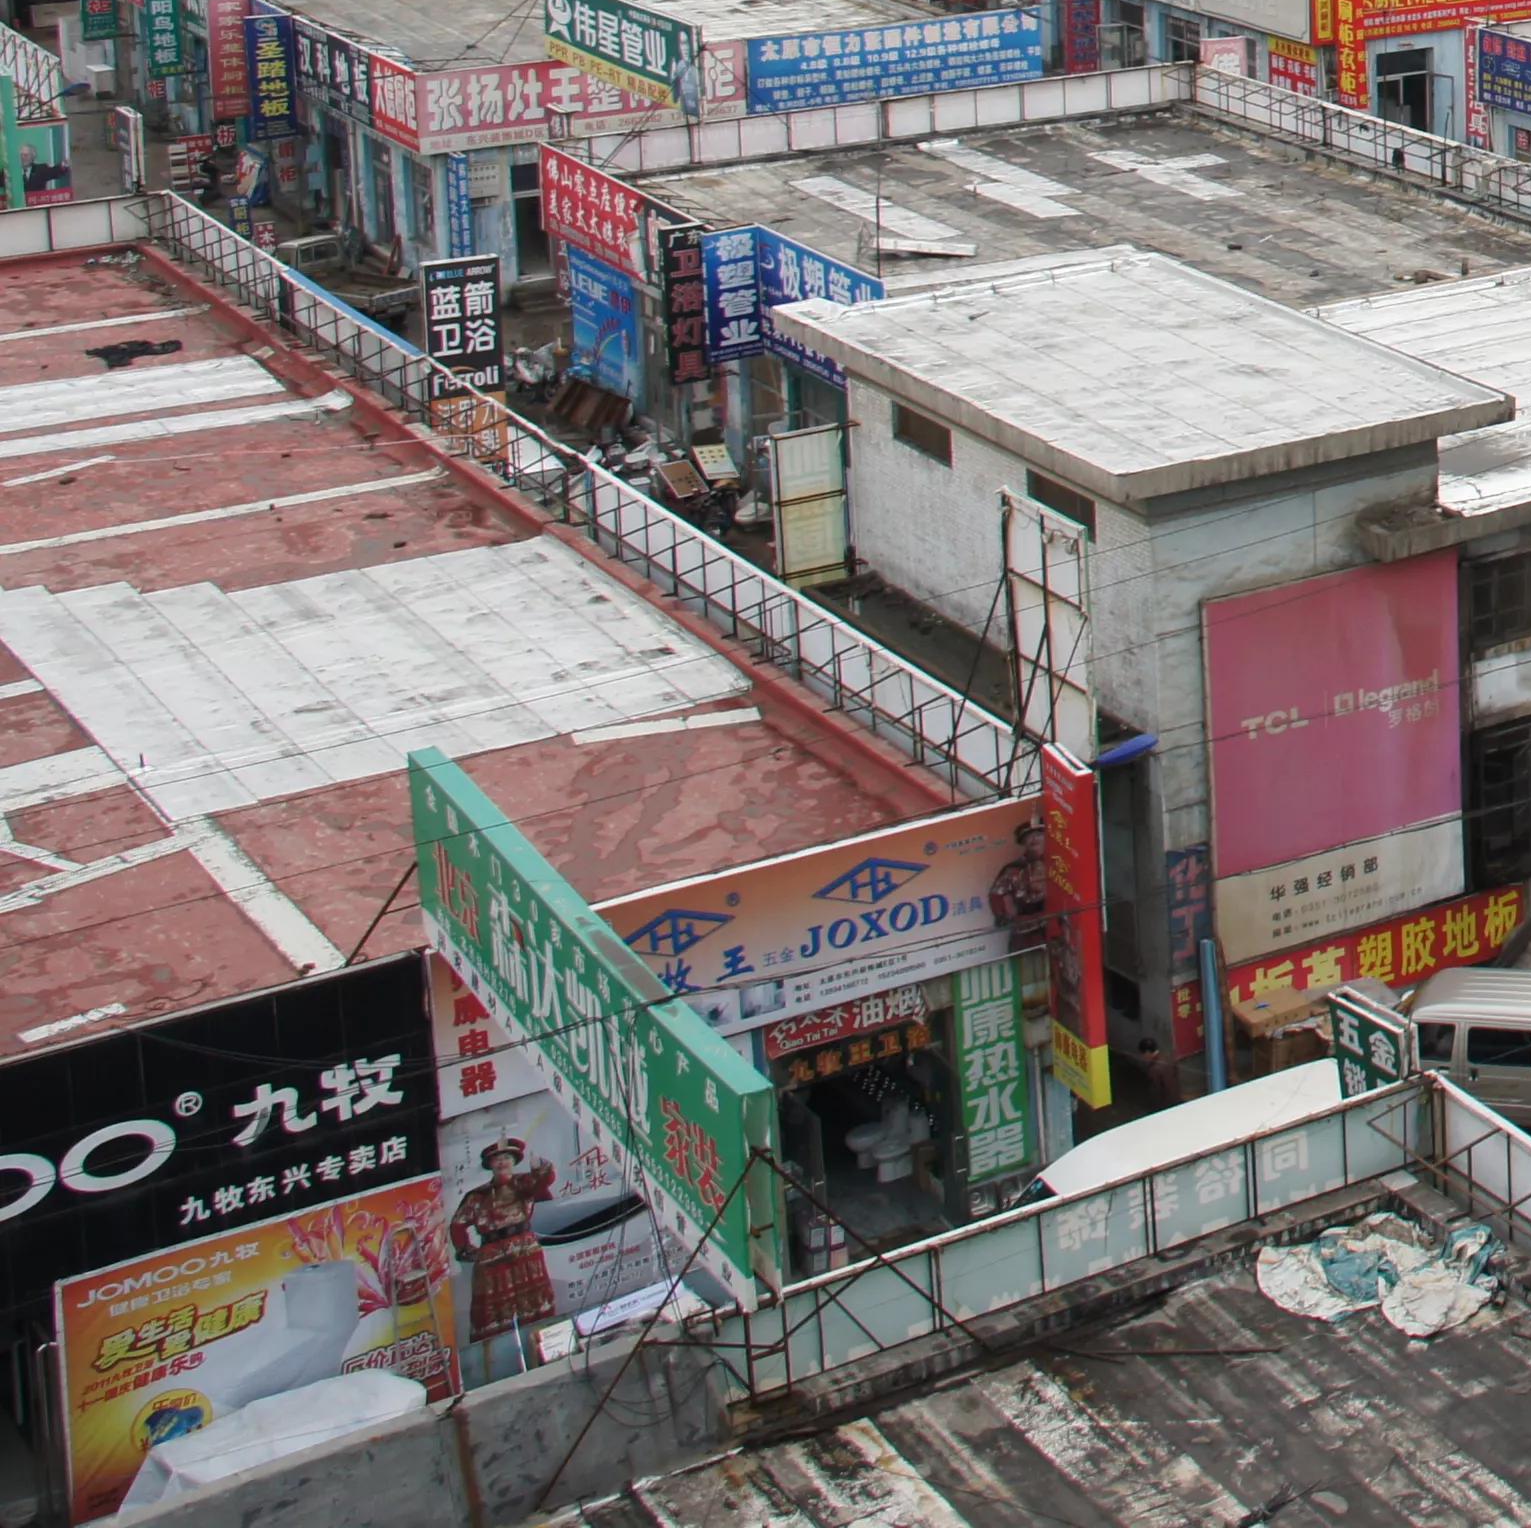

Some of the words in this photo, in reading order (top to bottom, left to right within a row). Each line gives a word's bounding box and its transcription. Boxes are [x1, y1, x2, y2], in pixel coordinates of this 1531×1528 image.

[430, 280, 496, 321] 蓝箭
[670, 247, 706, 383] 卫浴灯具
[431, 318, 497, 359] 卫浴
[432, 364, 500, 399] Ferroli
[1240, 705, 1311, 741] TCL
[1357, 667, 1441, 714] legrand
[434, 839, 480, 943] 北京
[1269, 855, 1380, 904] 华强经销部
[761, 946, 796, 969] 五金
[800, 892, 951, 960] JOXOD
[951, 895, 984, 919] 洁具
[1357, 889, 1521, 988] 塑胶地板
[449, 968, 499, 1099] 康电器
[768, 1005, 851, 1043] 巧太太
[804, 1030, 822, 1045] Tai
[821, 1026, 840, 1040] Tai
[1336, 1006, 1398, 1076] 五金
[233, 1052, 405, 1148] 九牧
[961, 959, 1026, 1174] 帅康热水器
[180, 1135, 409, 1227] 九牧东兴专卖店
[76, 1257, 207, 1310] JOMOO
[210, 1240, 262, 1271] 九牧
